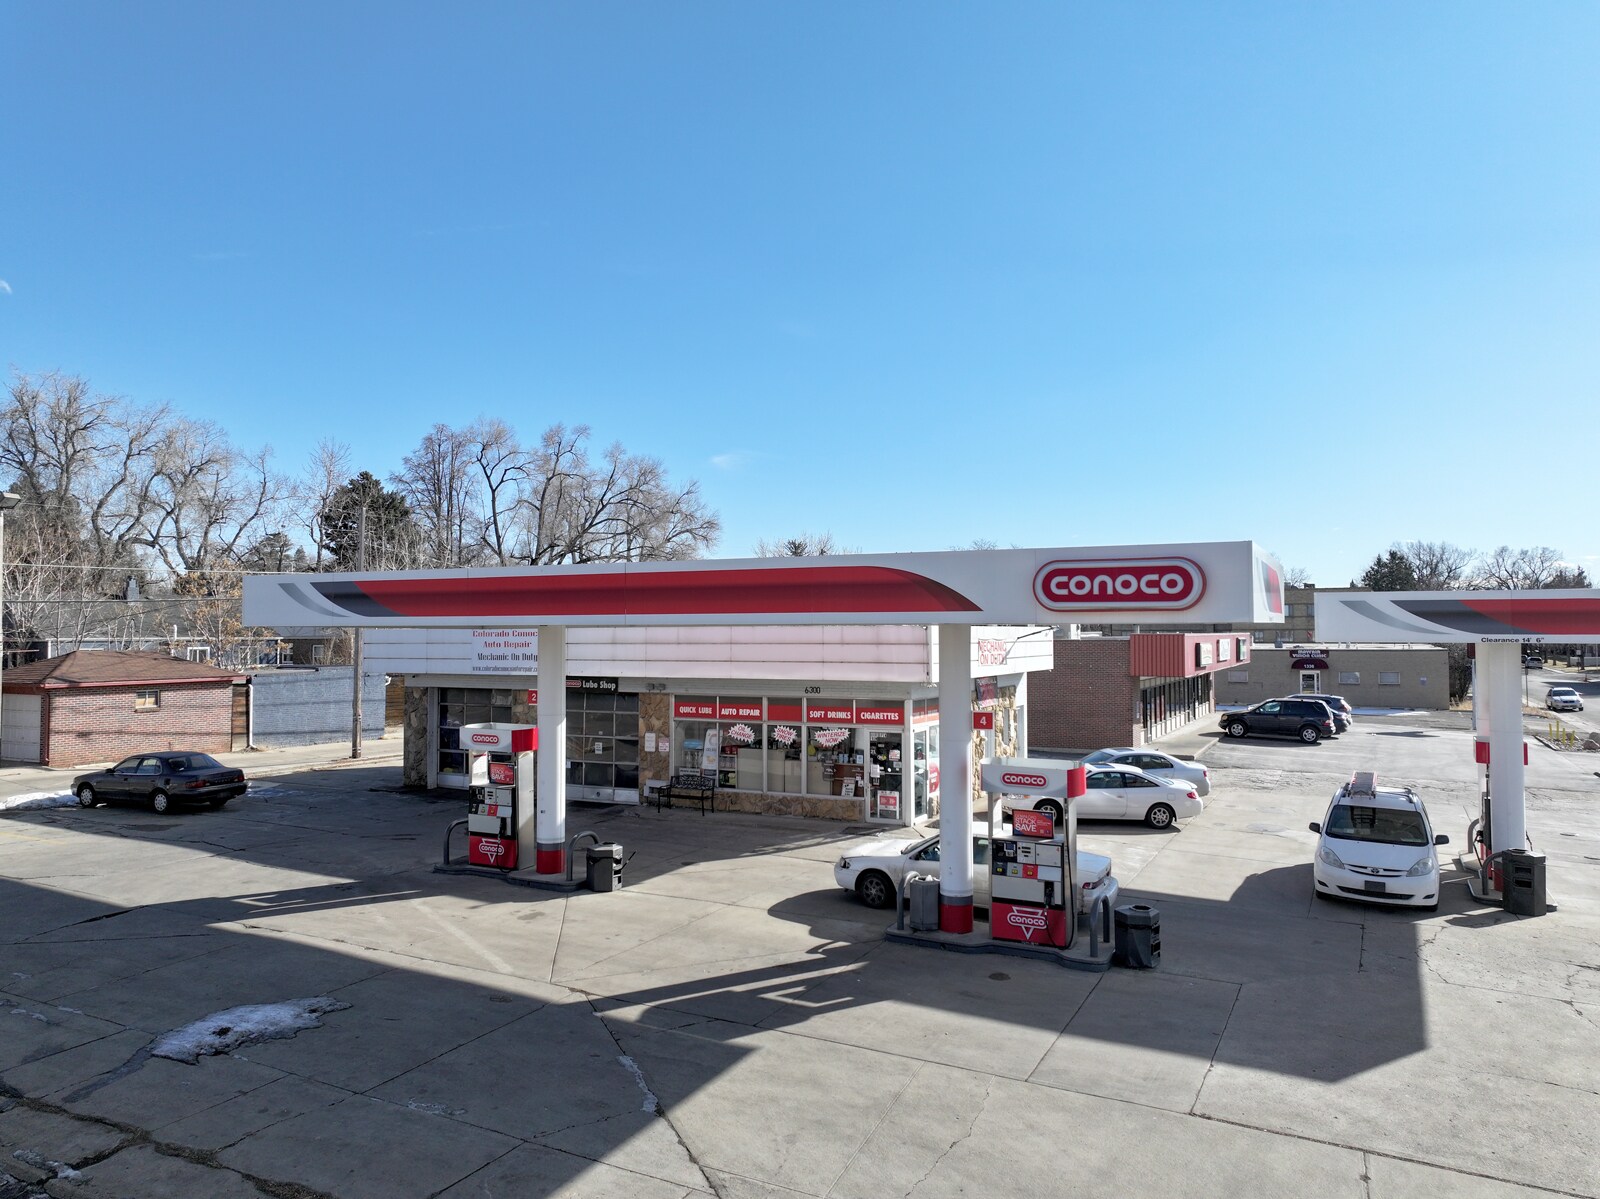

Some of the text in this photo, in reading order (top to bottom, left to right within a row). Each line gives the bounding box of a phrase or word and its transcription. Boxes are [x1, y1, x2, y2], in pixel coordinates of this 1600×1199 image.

[503, 641, 532, 649] Repair
[477, 653, 538, 662] Mechanic On Duty
[582, 680, 598, 689] Lube
[600, 681, 616, 691] Shop
[804, 686, 821, 694] 6300
[531, 693, 537, 701] 2
[679, 706, 760, 716] QUICK LUBE AUTO REPAIR
[809, 710, 899, 720] SOFT DRINKS CIGARETTES
[980, 716, 987, 726] 4
[1015, 817, 1037, 826] STACK
[1015, 823, 1037, 832] SAVE
